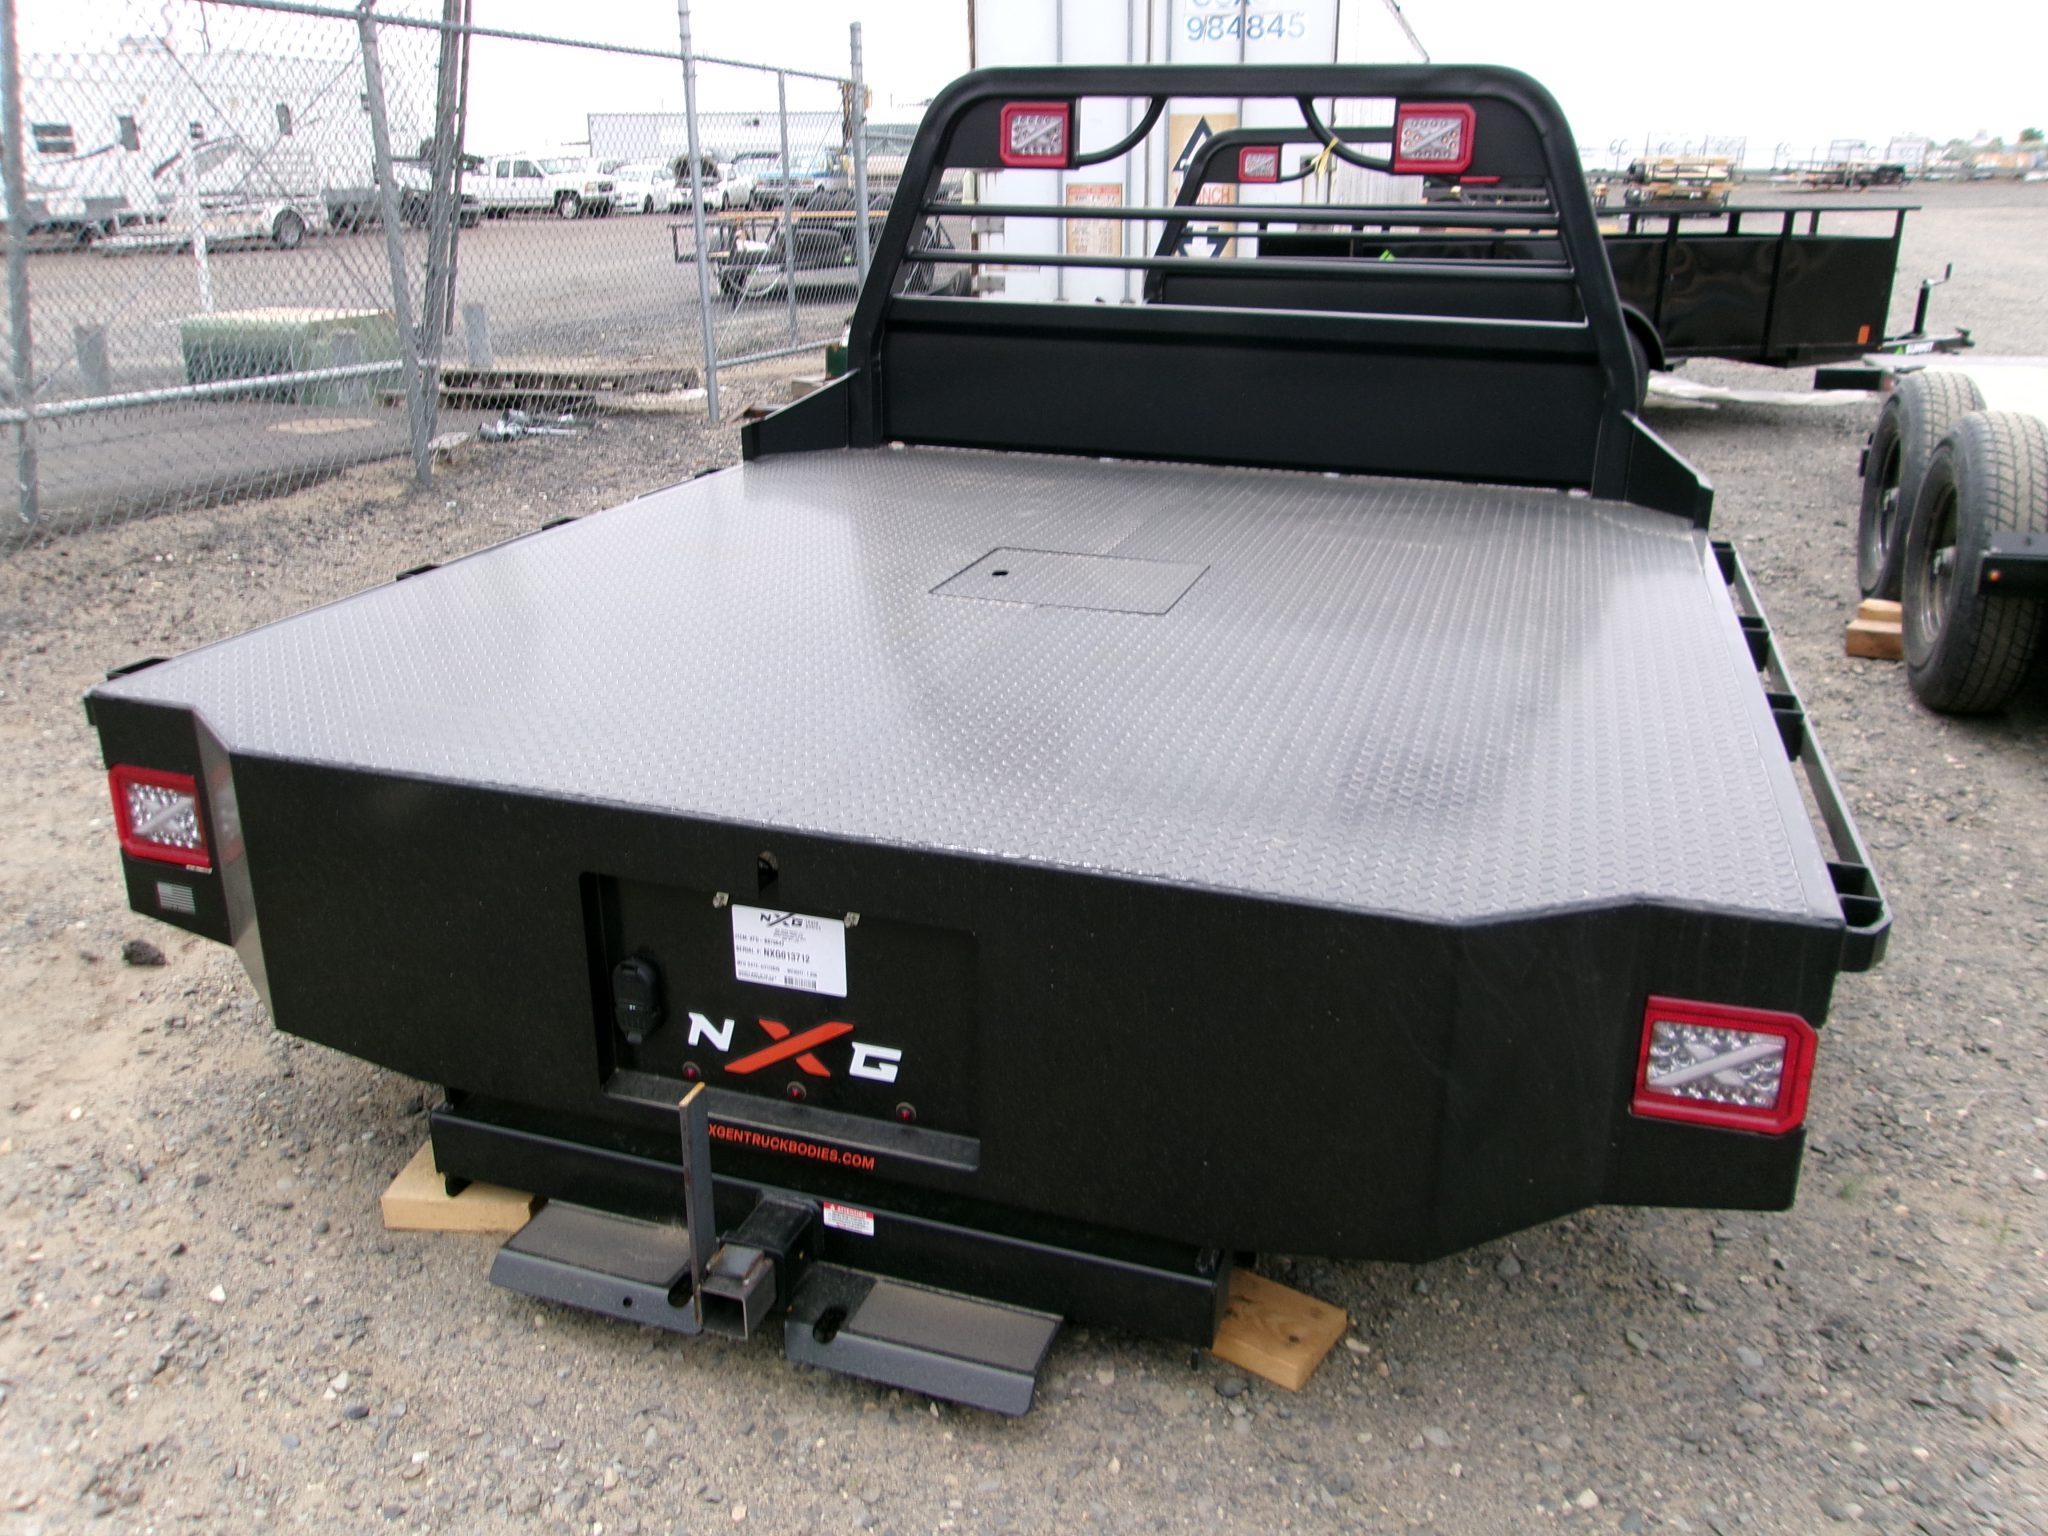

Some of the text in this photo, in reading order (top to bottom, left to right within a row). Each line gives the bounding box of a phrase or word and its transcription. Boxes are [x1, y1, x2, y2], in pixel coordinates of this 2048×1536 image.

[1187, 14, 1306, 40] 984845
[688, 1012, 902, 1083] NXG
[708, 1123, 875, 1170] XGENTRUCKBODIES.COM
